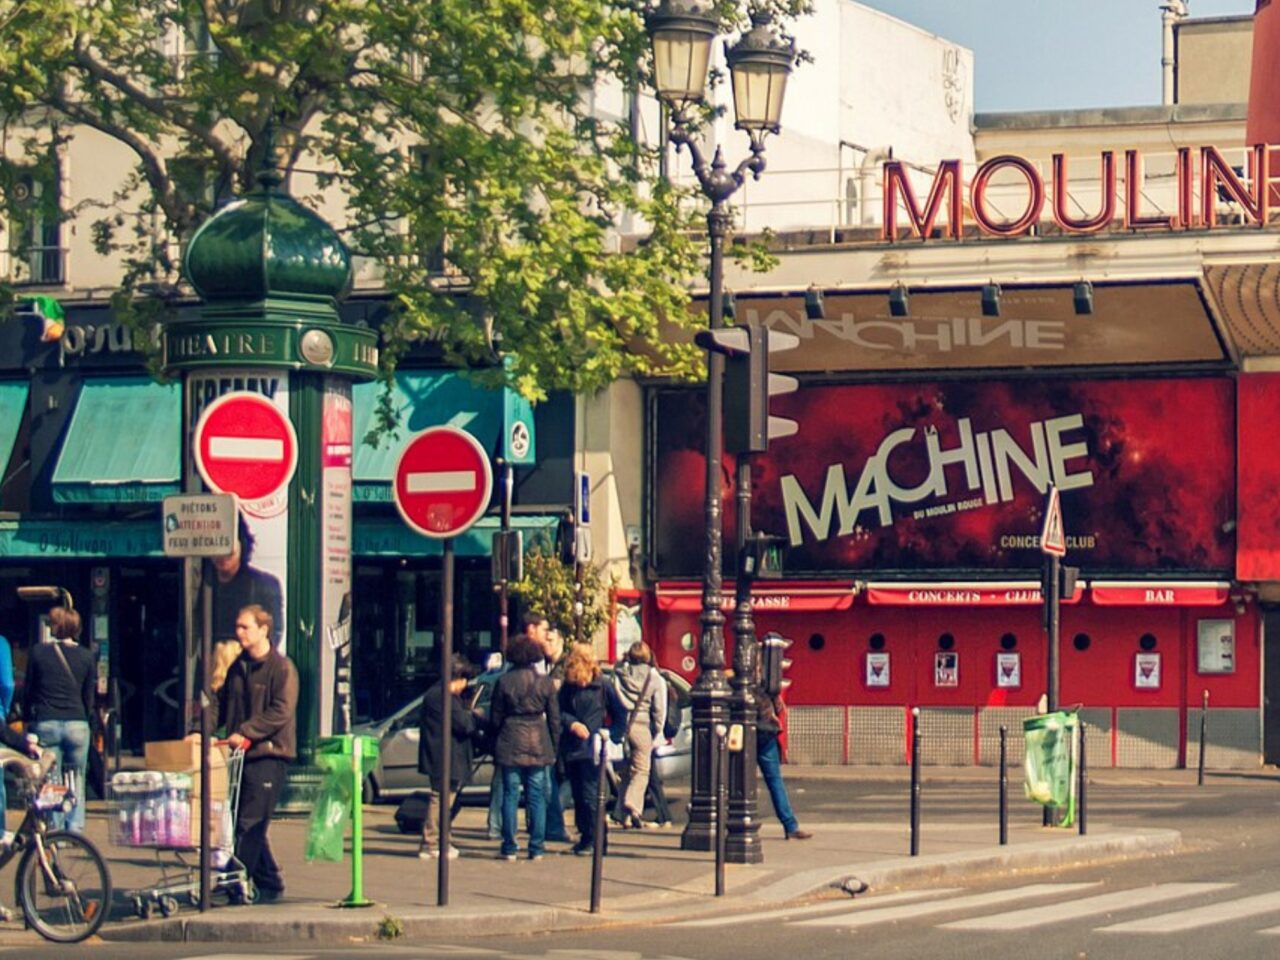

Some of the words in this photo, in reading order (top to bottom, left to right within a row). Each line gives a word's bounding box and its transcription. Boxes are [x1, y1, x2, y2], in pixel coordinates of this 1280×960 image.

[881, 143, 1270, 242] MOULIN
[780, 413, 1094, 547] MACHINE
[180, 501, 217, 513] PIÉTONS
[926, 503, 956, 519] MOULIN
[957, 498, 984, 512] ROUGE
[1066, 535, 1096, 548] CLUB
[908, 590, 981, 602] CONCERTS
[1004, 590, 1042, 602] CLUB
[1144, 590, 1175, 602] BAR
